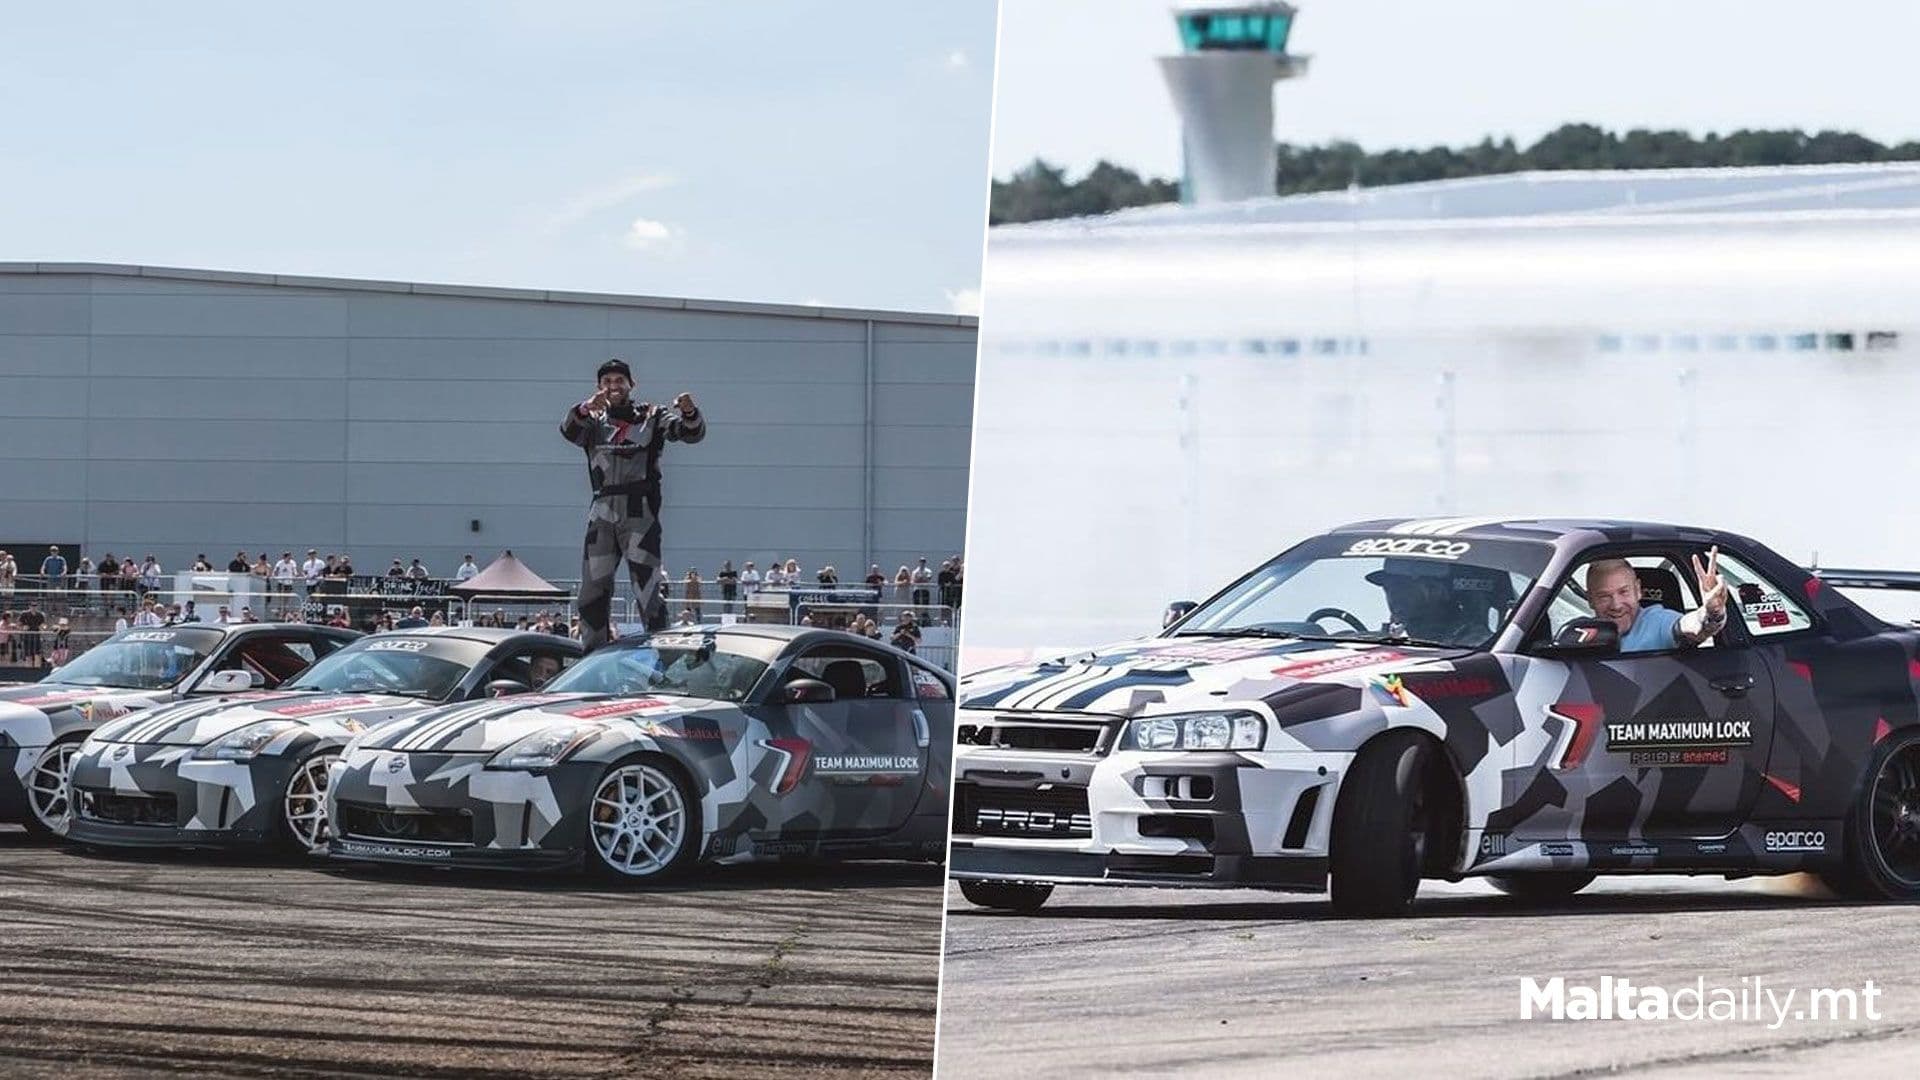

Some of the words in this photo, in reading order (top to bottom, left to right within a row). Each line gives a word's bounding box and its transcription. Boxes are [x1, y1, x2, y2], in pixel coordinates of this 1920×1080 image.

[1608, 724, 1645, 741] TEAM
[1649, 722, 1713, 740] MAXIMUM
[1717, 721, 1751, 738] LOCK
[814, 757, 843, 769] TEAM
[845, 757, 893, 769] MAXIMUM
[895, 757, 919, 769] LOCK
[1765, 831, 1825, 851] sparco
